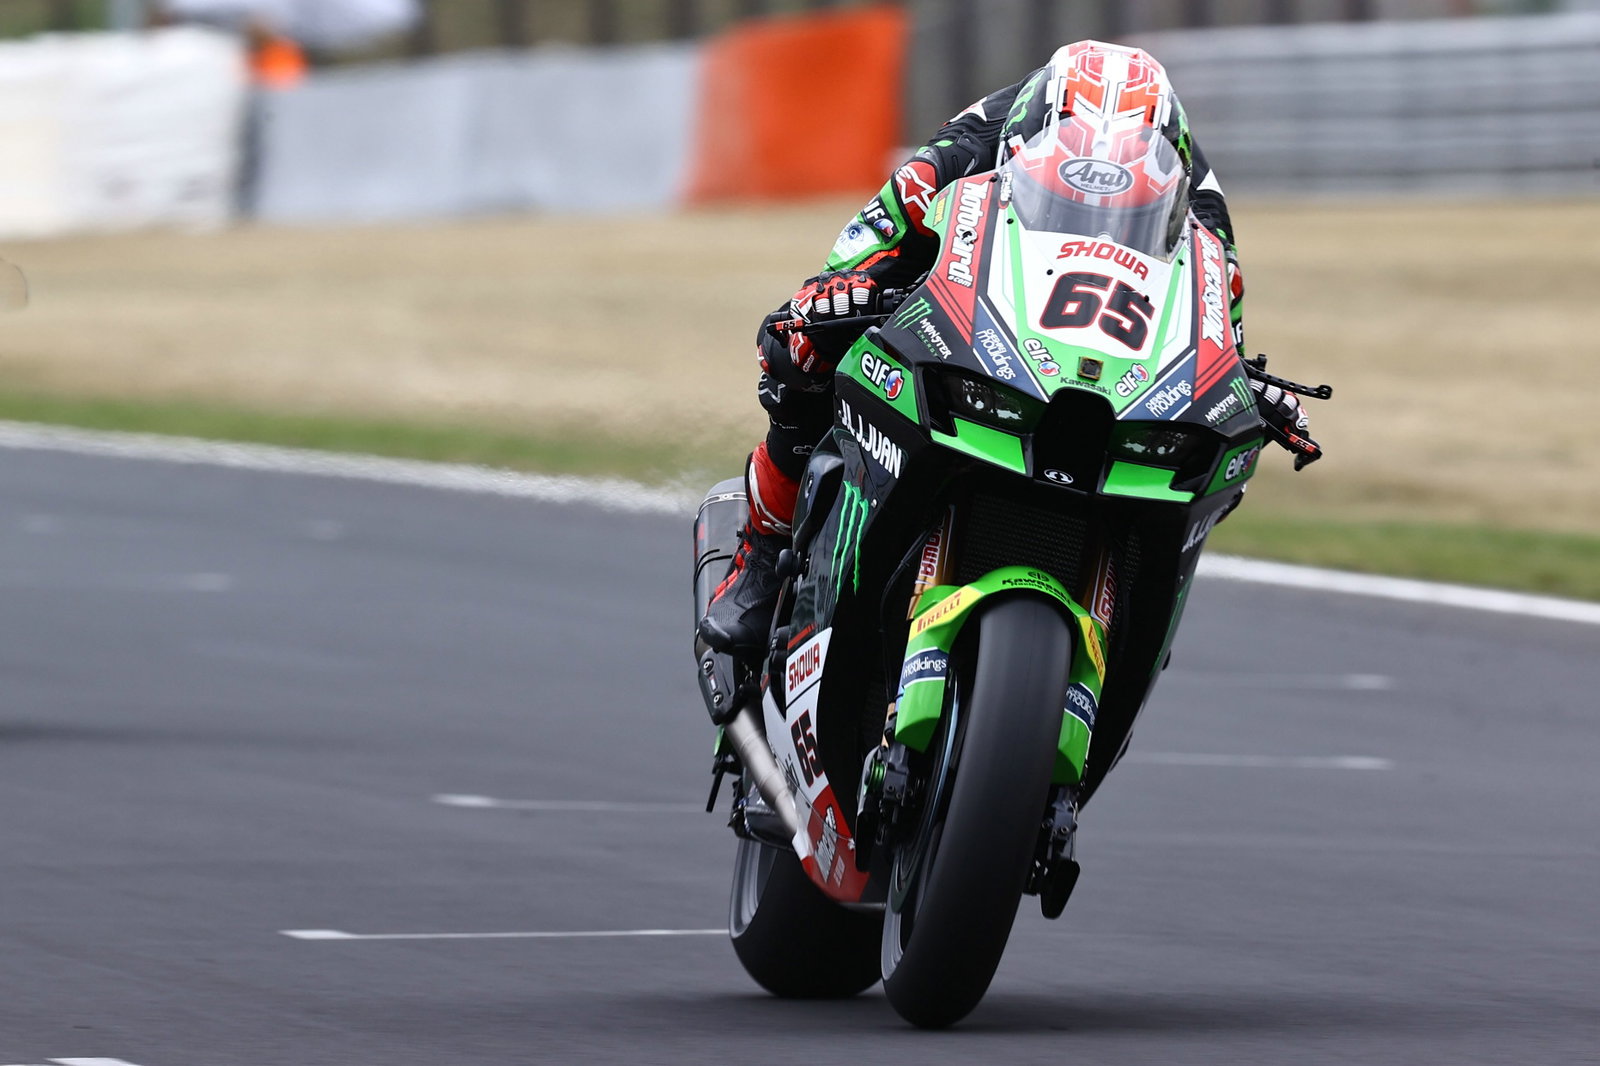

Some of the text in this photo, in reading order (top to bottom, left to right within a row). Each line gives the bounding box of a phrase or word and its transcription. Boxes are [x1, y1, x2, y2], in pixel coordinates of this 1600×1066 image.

[1064, 163, 1126, 187] Arai
[1056, 240, 1149, 281] SHOWA
[1039, 270, 1155, 351] 65
[919, 317, 952, 360] MONSTER
[860, 351, 892, 389] elf
[1060, 376, 1112, 396] Kawasaki
[789, 642, 820, 692] SHOWA
[791, 708, 825, 788] 65
